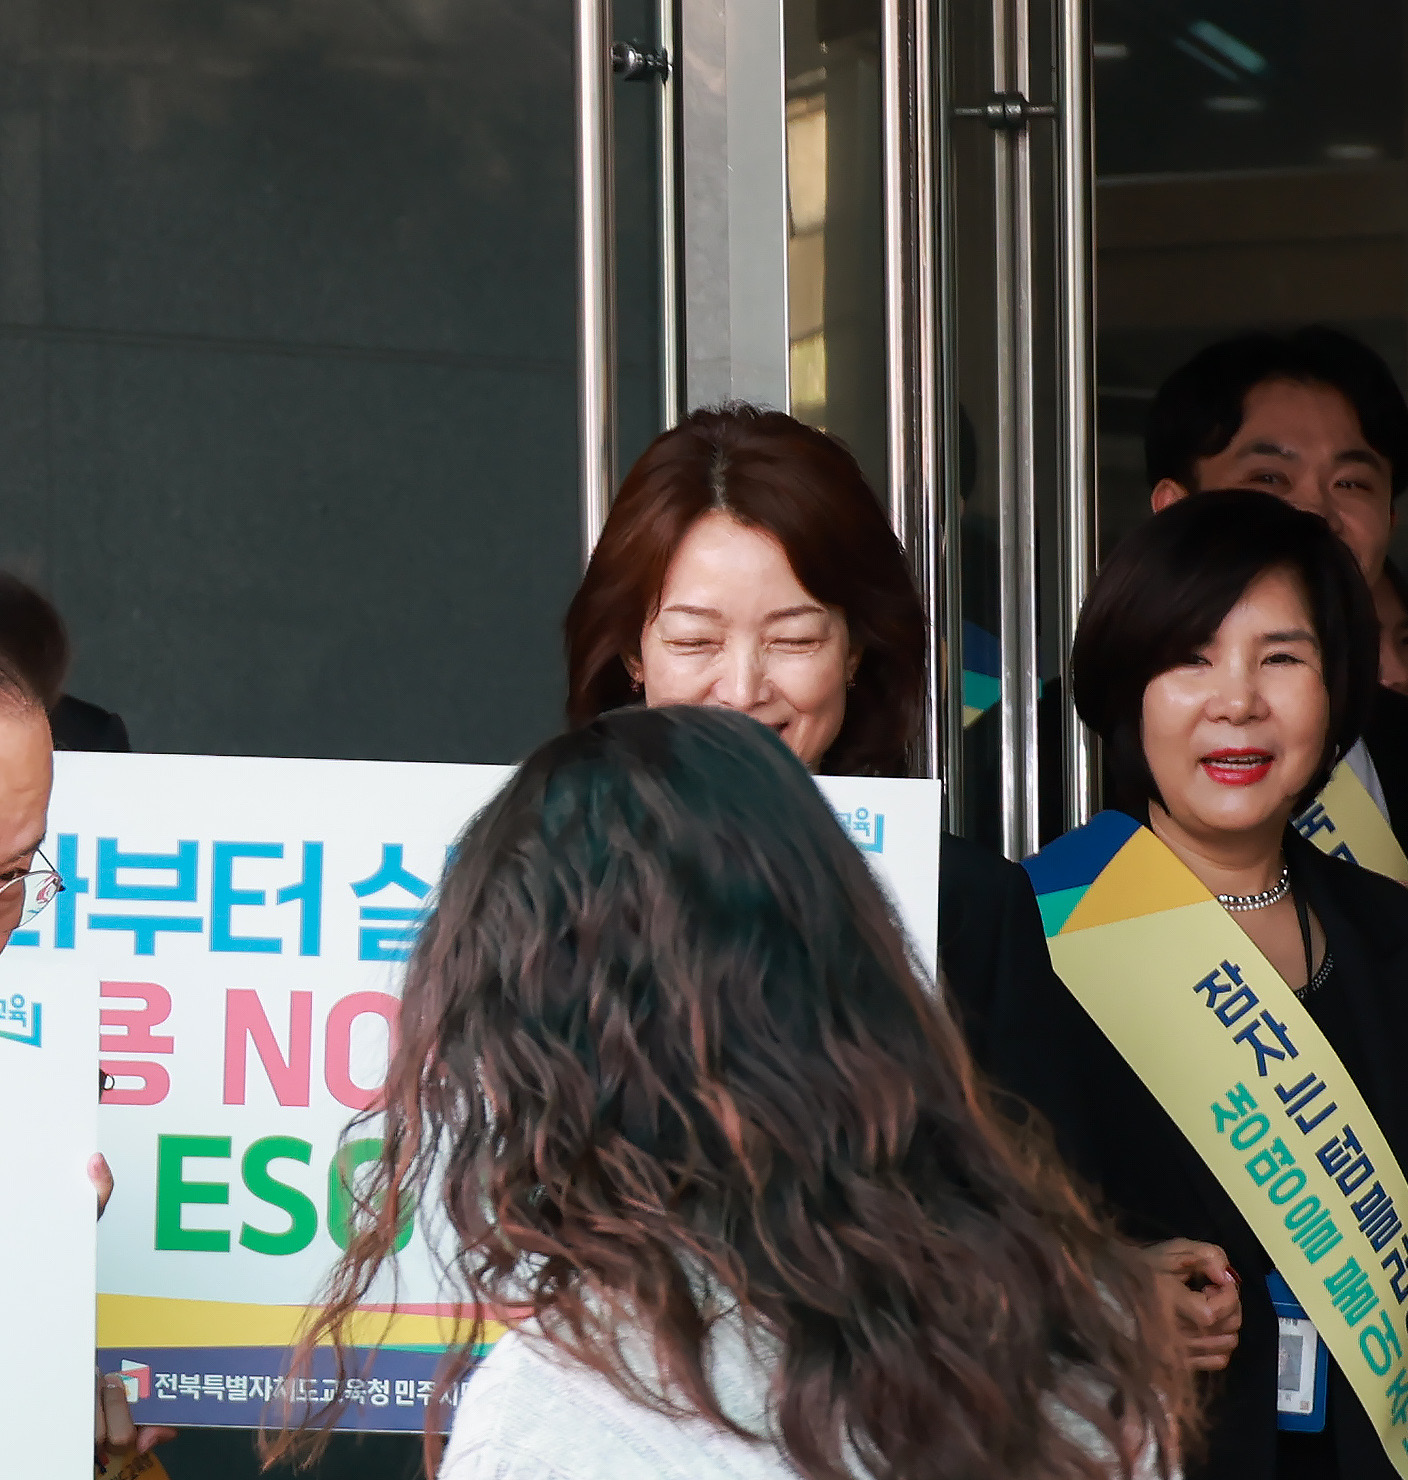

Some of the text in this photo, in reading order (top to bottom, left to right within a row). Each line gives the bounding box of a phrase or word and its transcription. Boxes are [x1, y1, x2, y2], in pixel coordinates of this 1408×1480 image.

[1193, 958, 1335, 1135] 잠자는
[1210, 1082, 1343, 1265] 생명을
[154, 1372, 470, 1407] 전북특별자치도교육청 민주시
